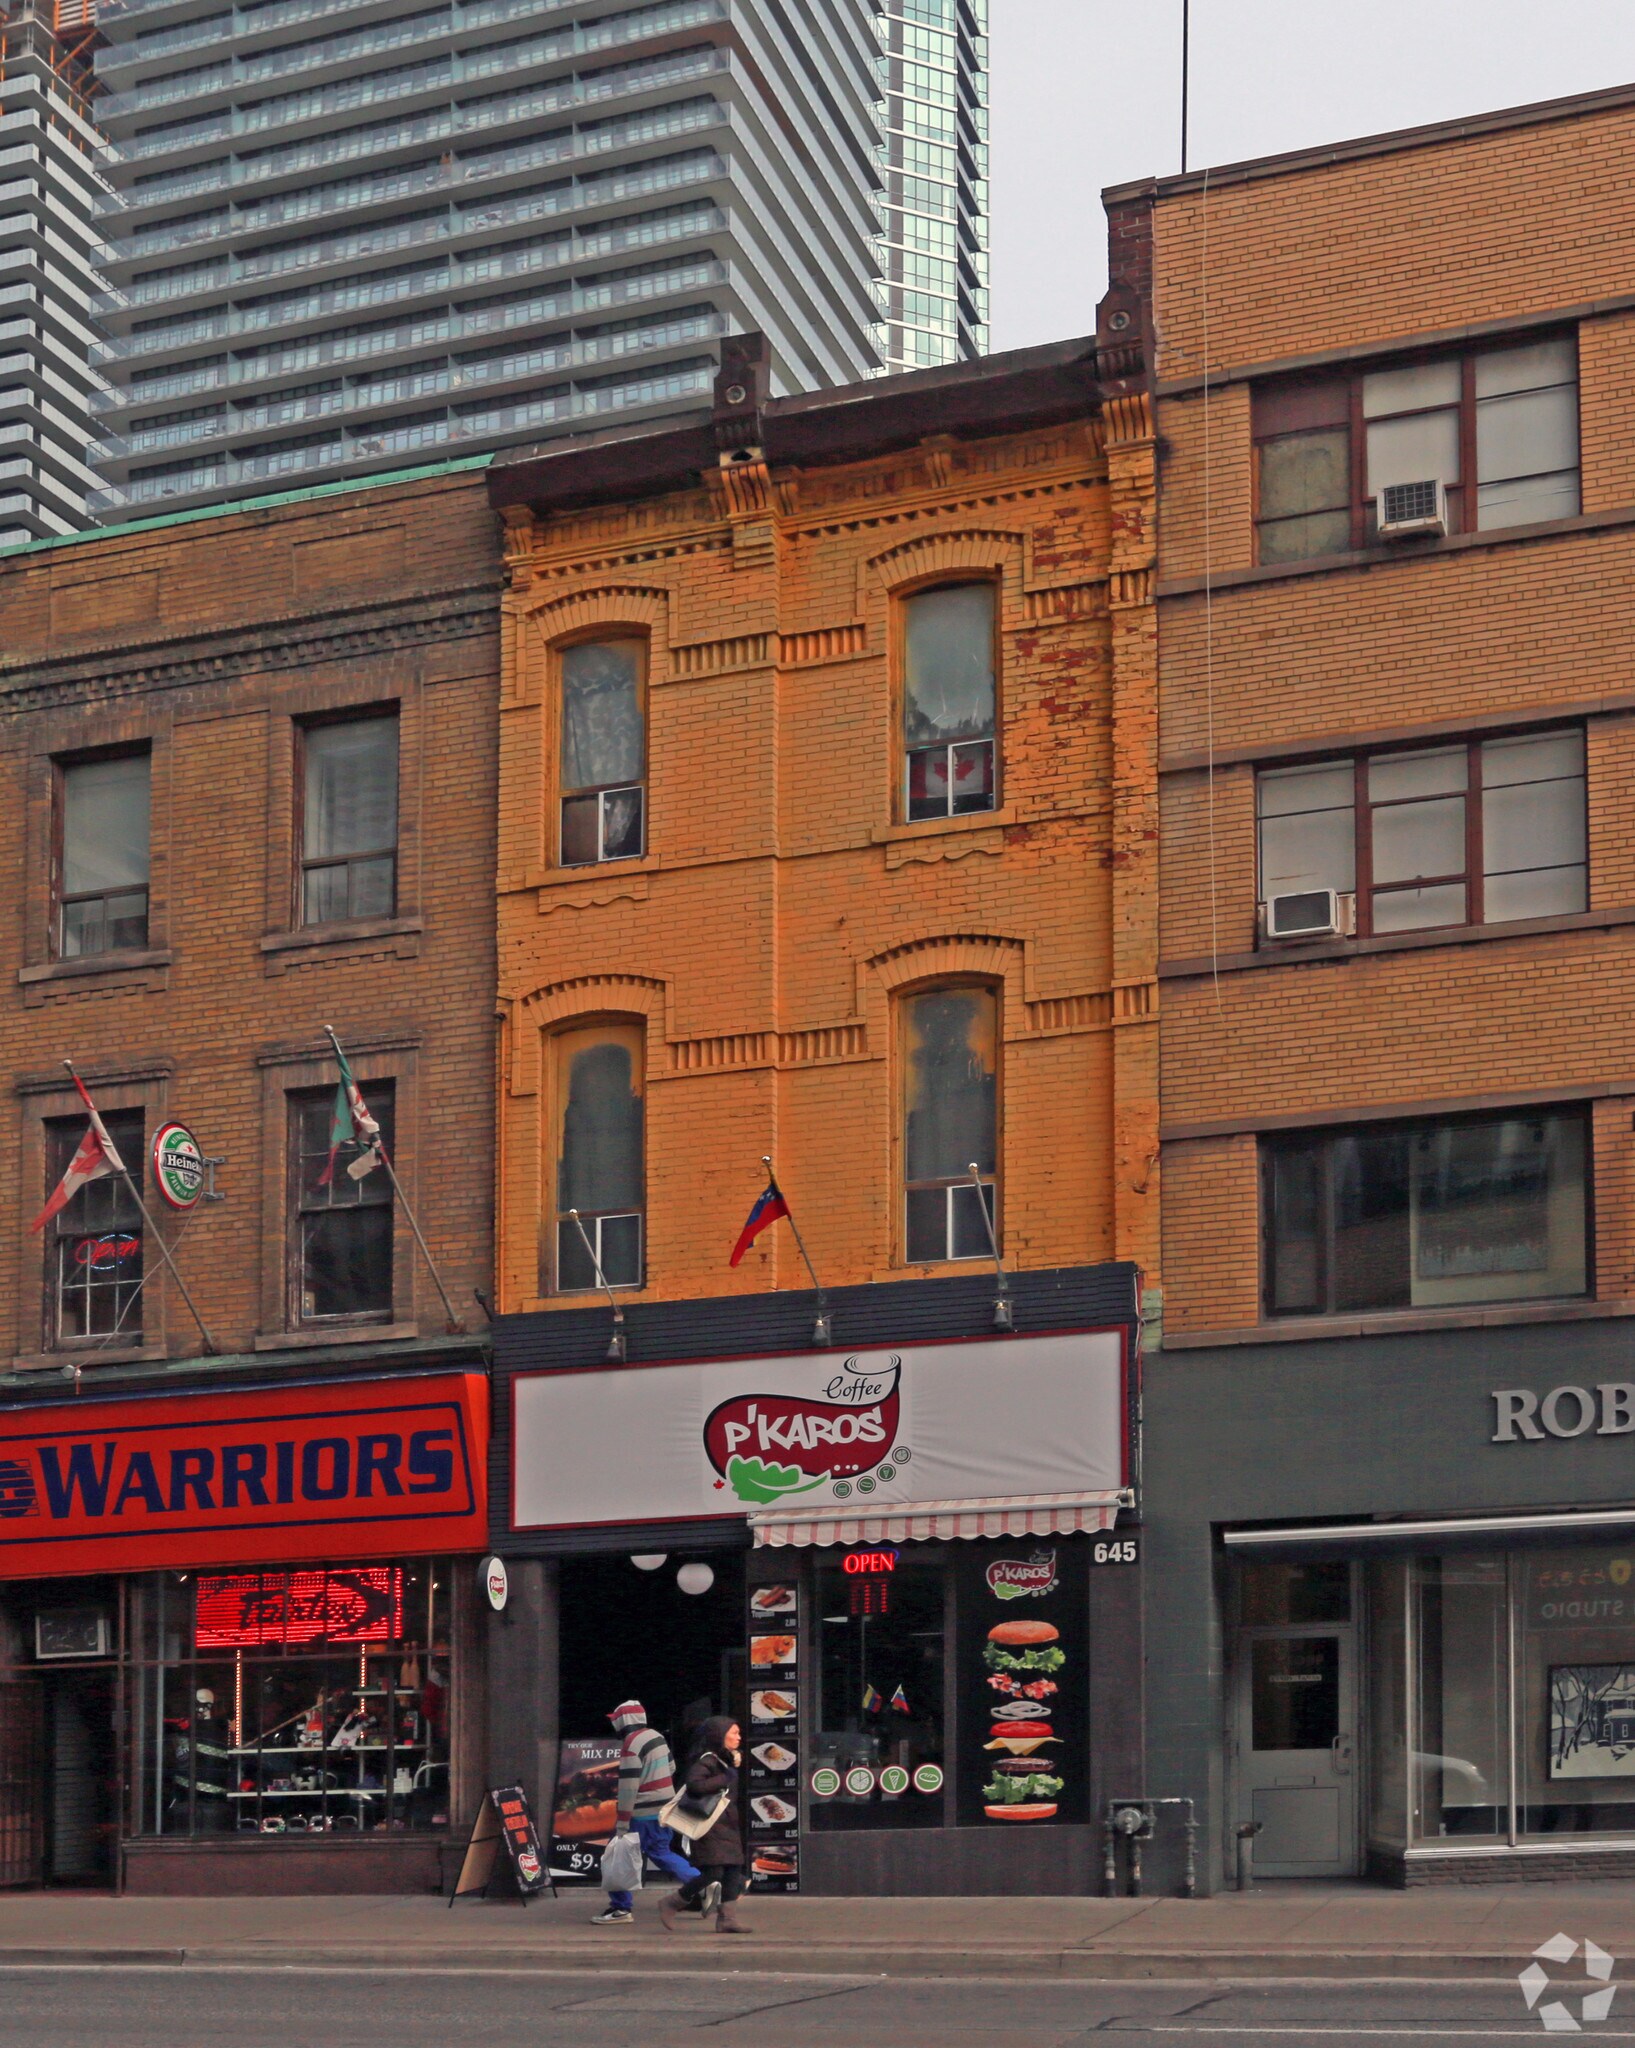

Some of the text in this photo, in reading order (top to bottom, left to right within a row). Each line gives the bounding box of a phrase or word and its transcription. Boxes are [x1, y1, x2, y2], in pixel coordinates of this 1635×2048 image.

[167, 1153, 202, 1173] Heinek
[822, 1375, 882, 1402] Coffee
[724, 1403, 886, 1453] P'KAROS
[35, 1429, 454, 1519] WARRIORS
[844, 1552, 895, 1574] OPEN
[1094, 1541, 1137, 1563] 645
[994, 1563, 1051, 1581] P'KAROS
[581, 1749, 603, 1759] MIX
[556, 1843, 579, 1852] ONLY
